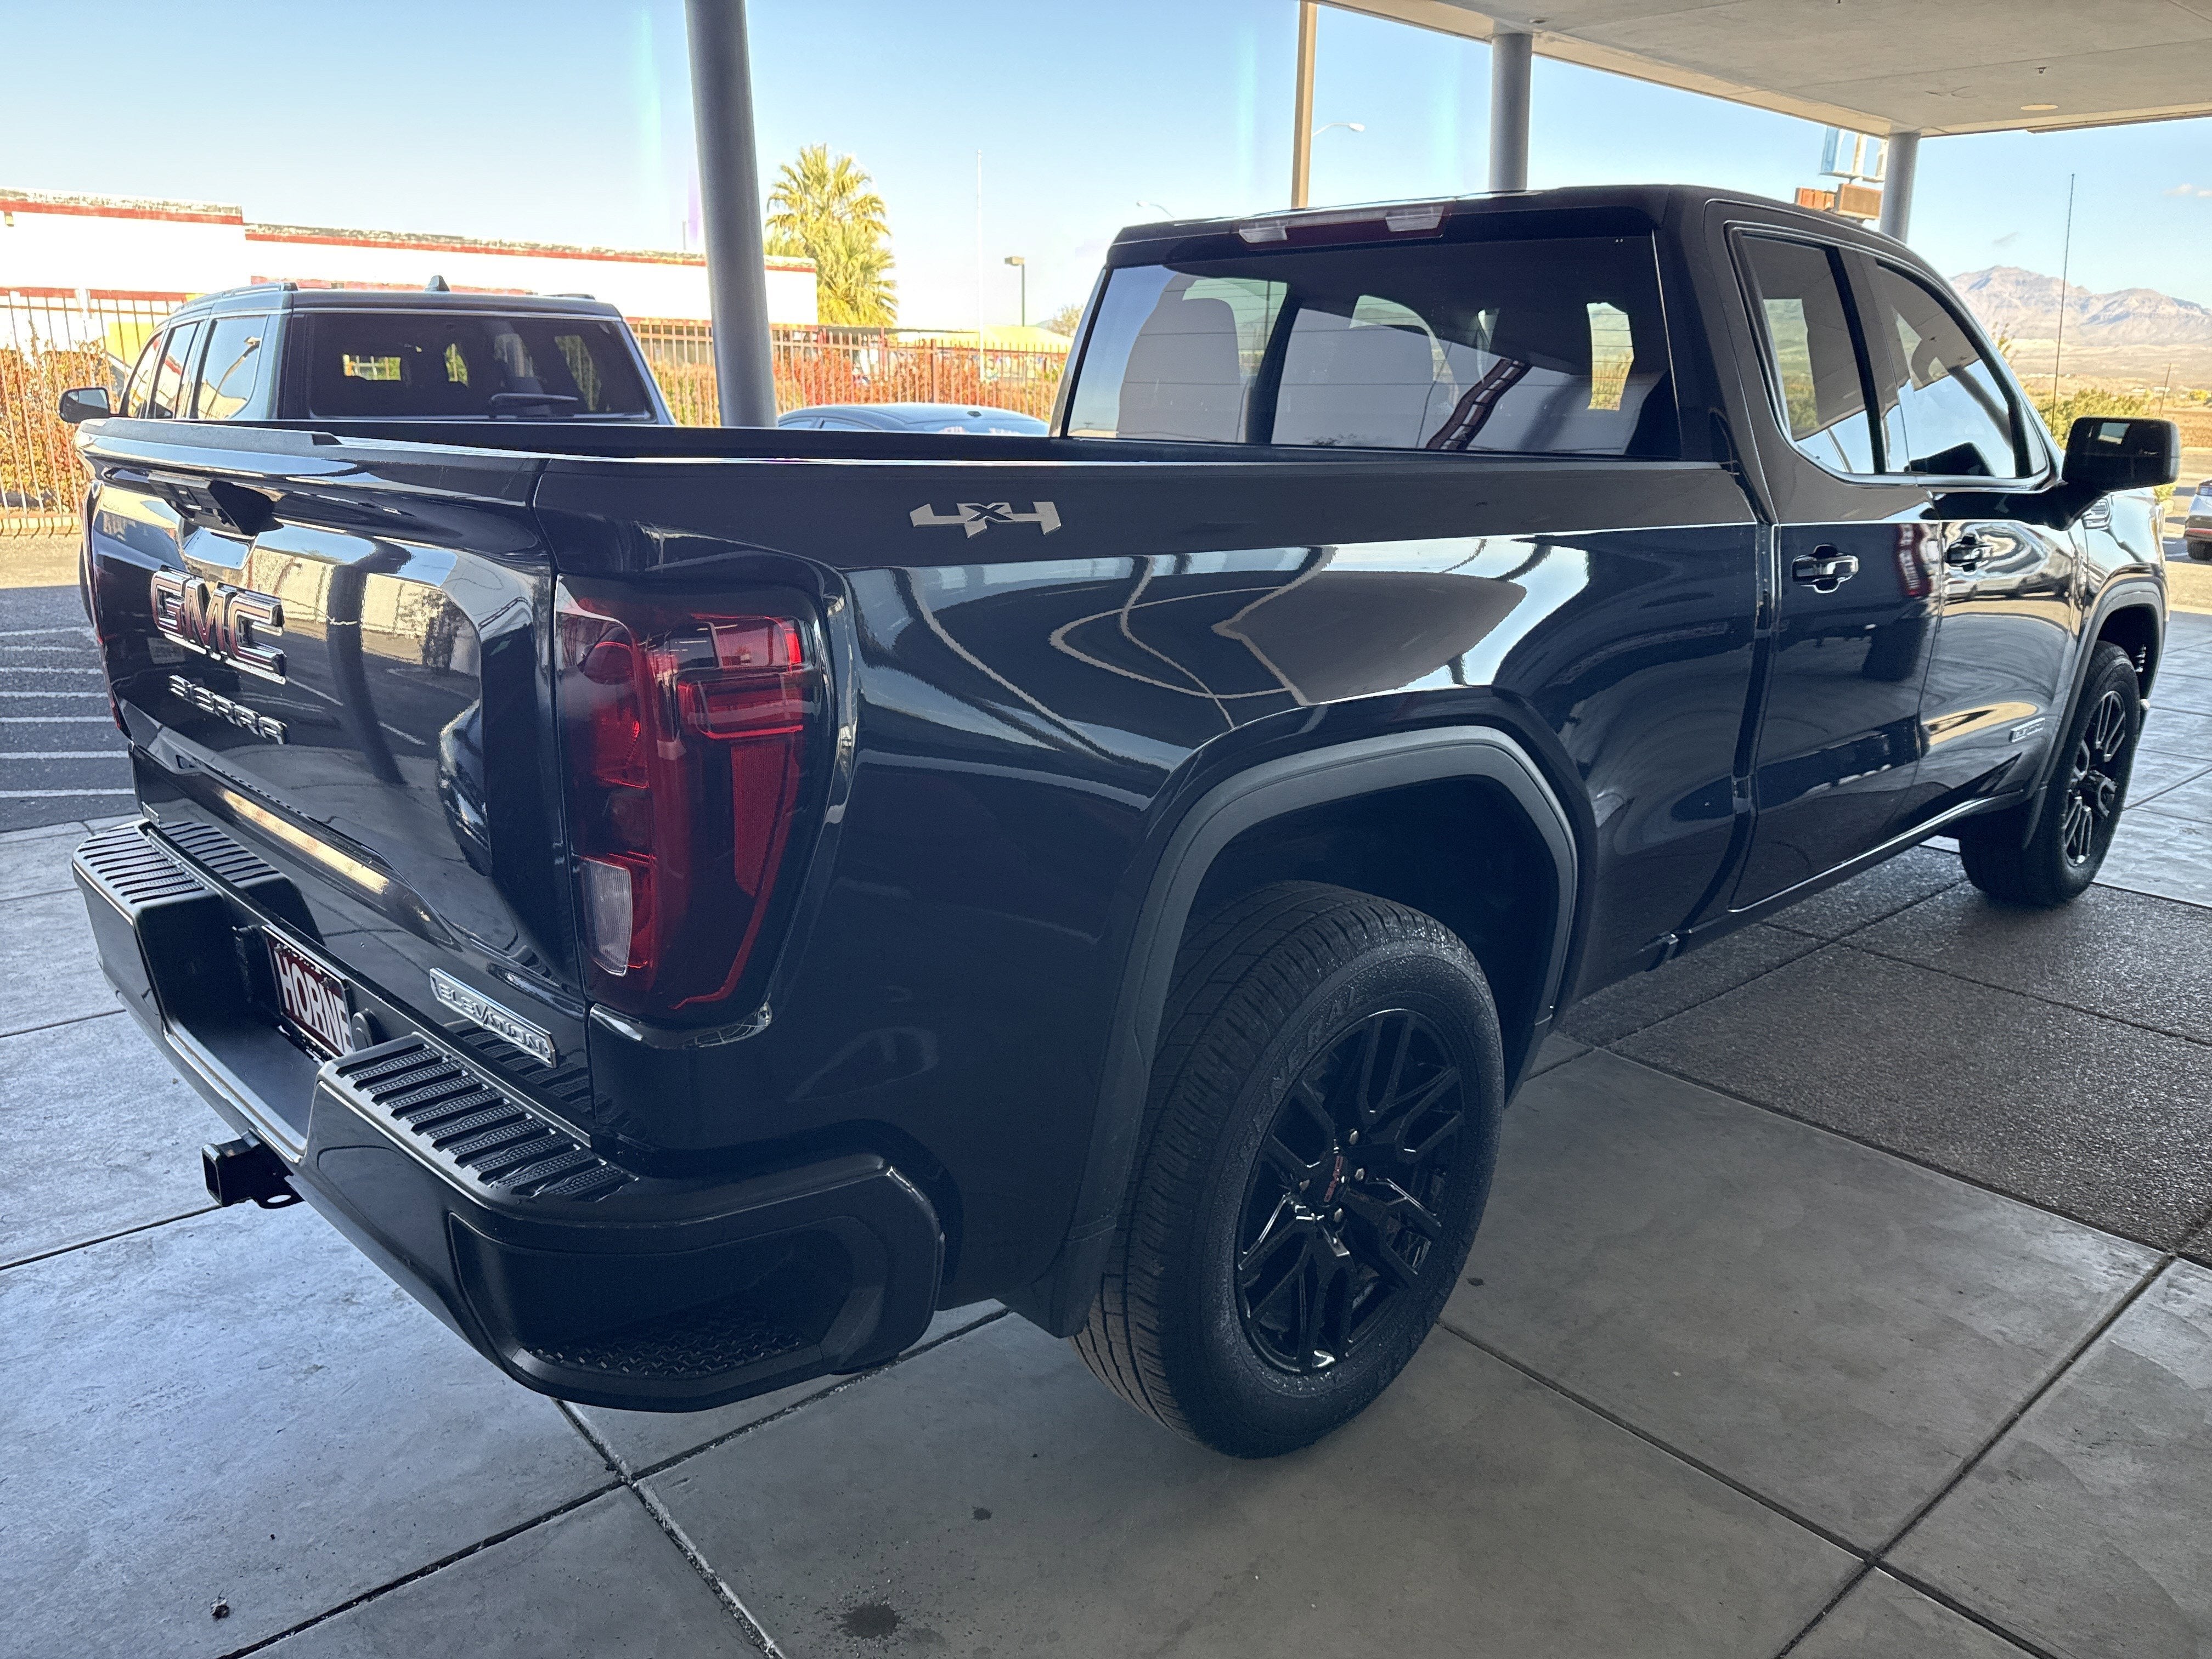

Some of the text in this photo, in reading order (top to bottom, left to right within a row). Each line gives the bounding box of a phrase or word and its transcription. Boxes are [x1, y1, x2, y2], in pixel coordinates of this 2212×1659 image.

[150, 569, 286, 682] GMC
[168, 674, 287, 745] SIERRA
[274, 950, 354, 1054] HORNE
[438, 983, 544, 1056] ELEVATION
